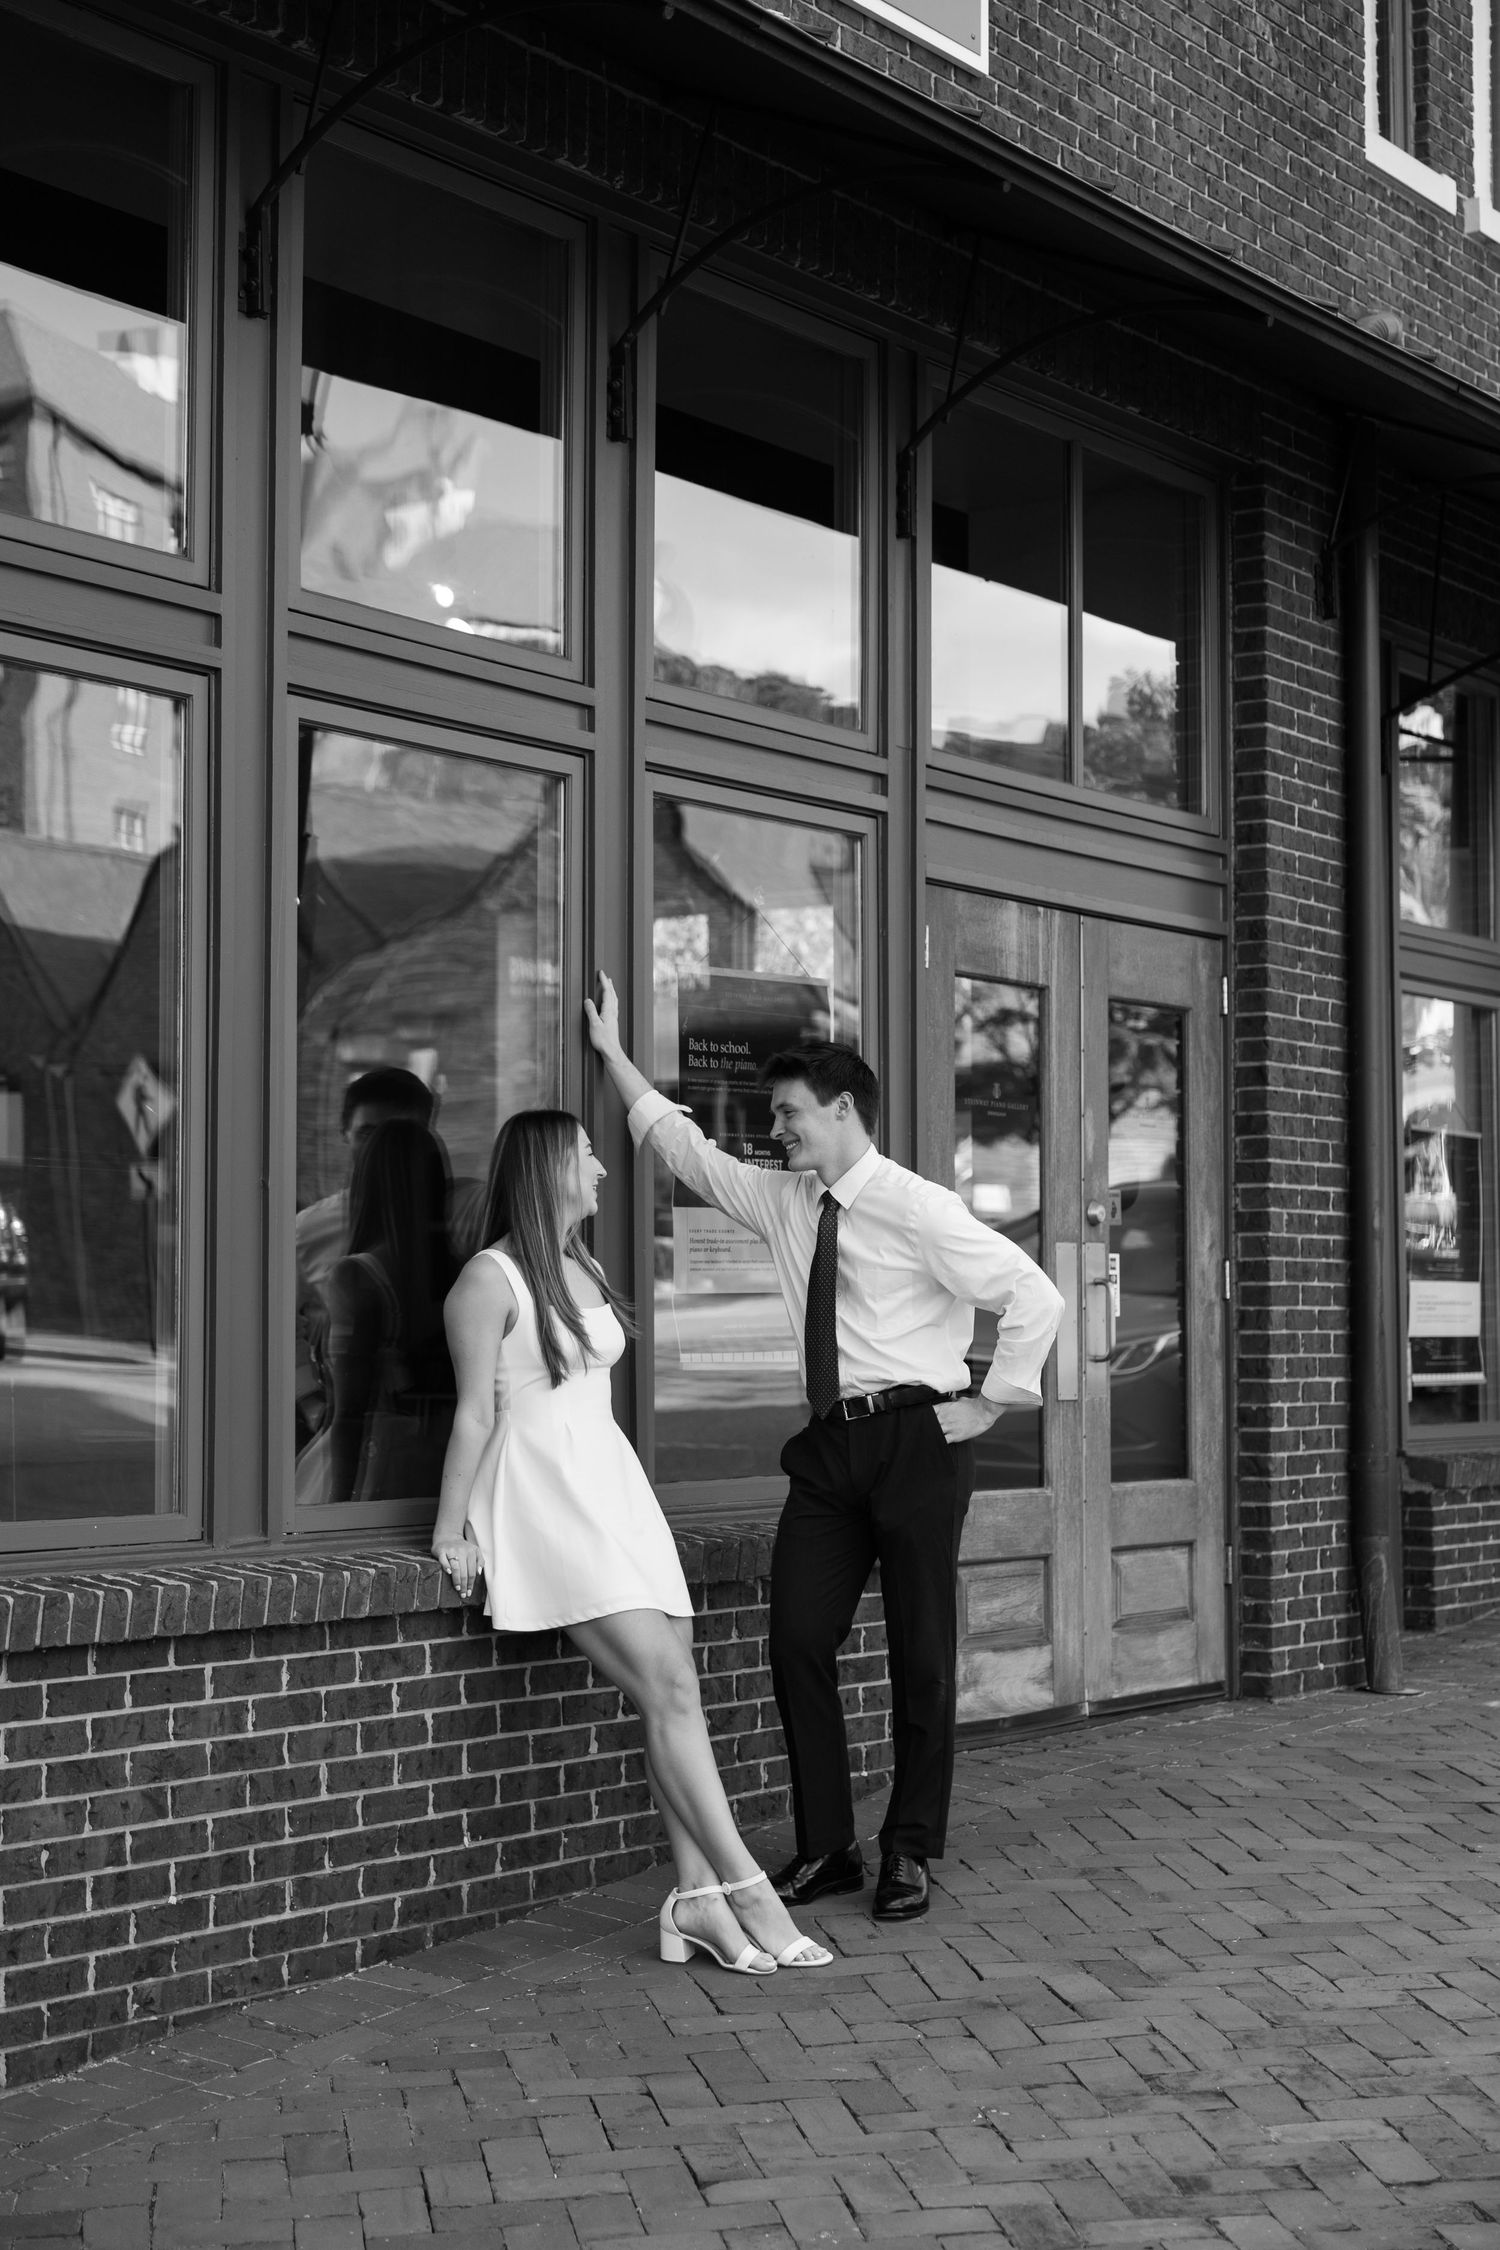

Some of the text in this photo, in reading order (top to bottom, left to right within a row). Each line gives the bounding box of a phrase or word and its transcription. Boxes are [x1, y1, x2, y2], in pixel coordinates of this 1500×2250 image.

[688, 1037, 751, 1055] Back to school.
[688, 1054, 759, 1074] Back to the piano.
[743, 1142, 753, 1155] 18
